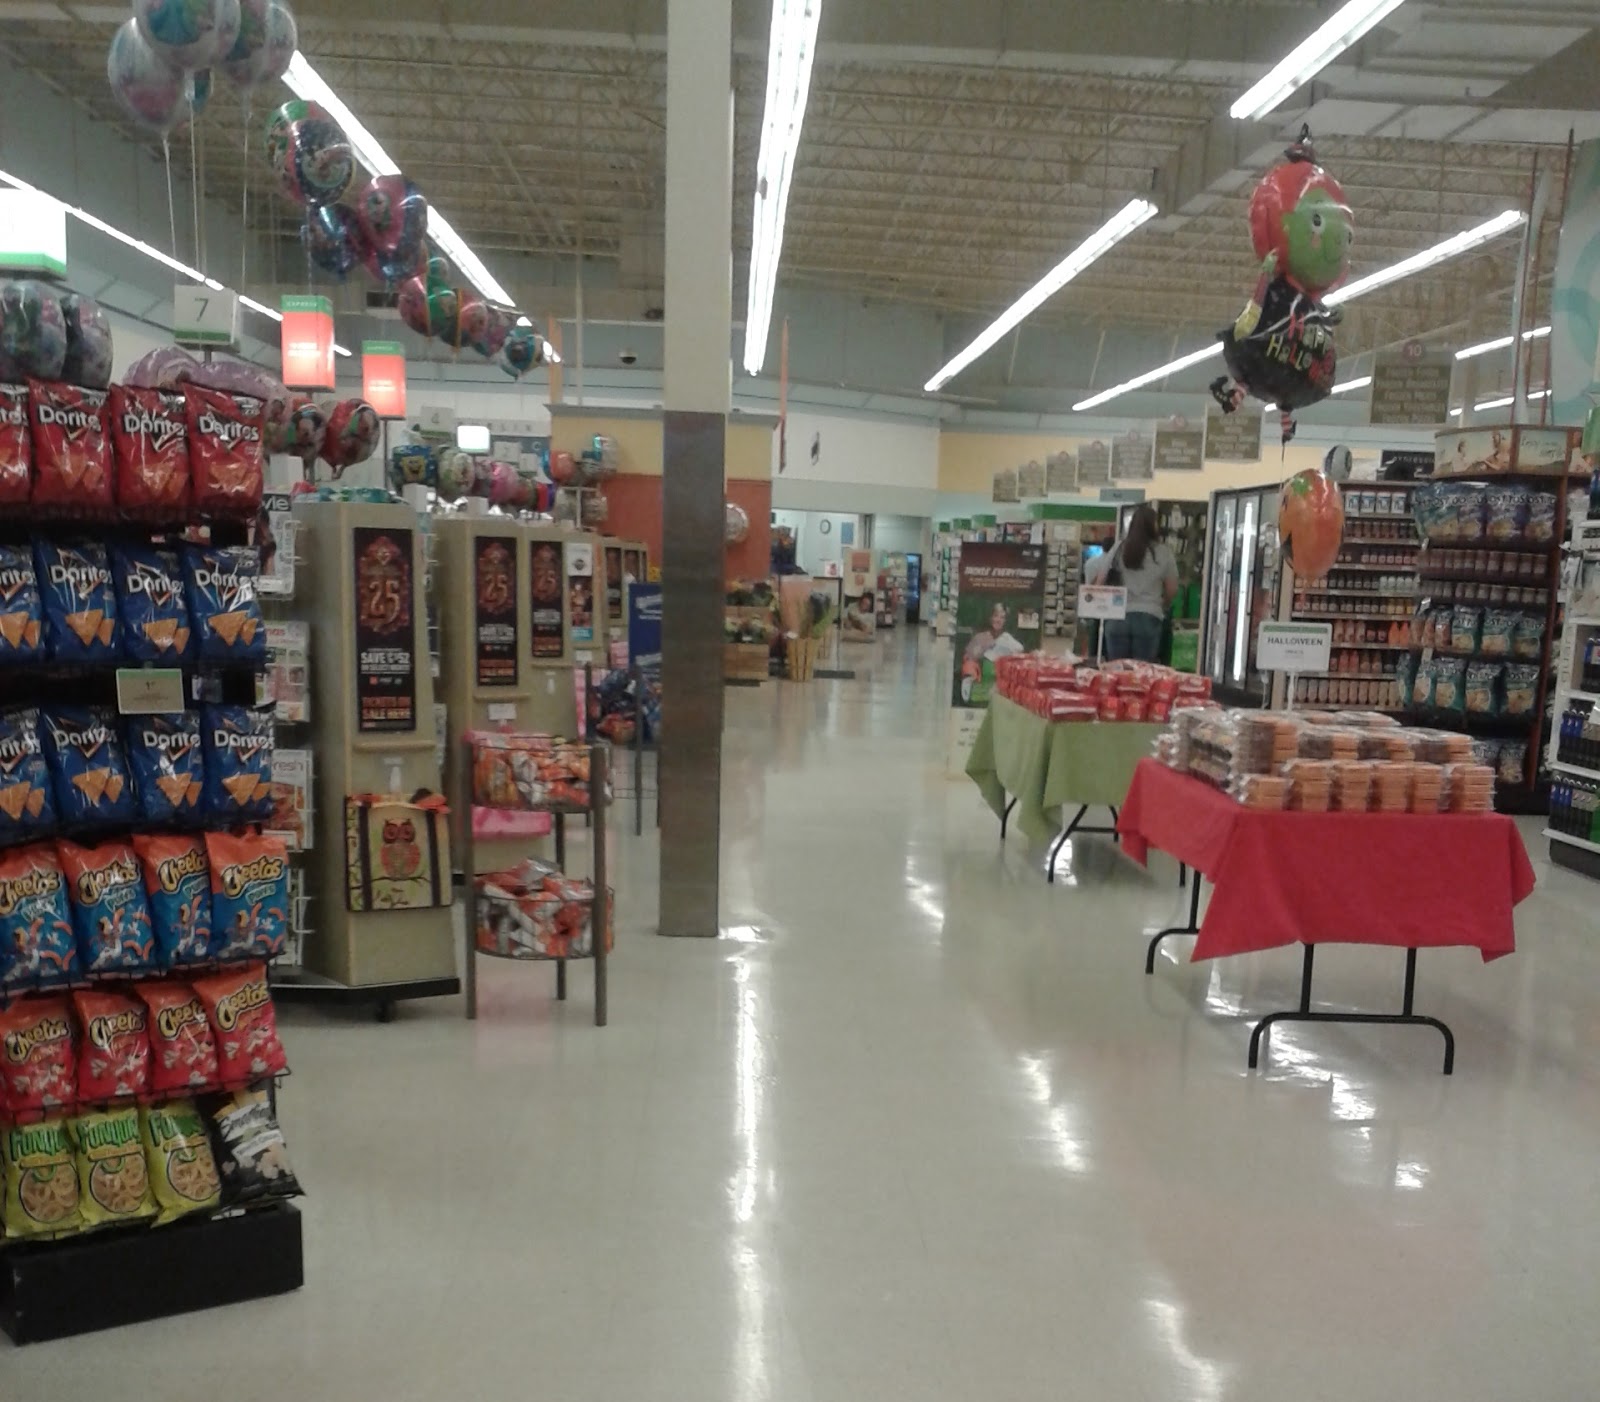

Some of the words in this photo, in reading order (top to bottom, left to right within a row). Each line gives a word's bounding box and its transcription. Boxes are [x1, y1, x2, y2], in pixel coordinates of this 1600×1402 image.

[194, 297, 209, 322] 7
[1407, 344, 1422, 357] 10
[199, 413, 260, 442] Doritos
[0, 566, 36, 585] ritos
[195, 569, 259, 590] Doritos
[1267, 636, 1323, 646] HALLOWEEN
[360, 652, 386, 664] SAVE
[143, 731, 200, 750] Dorito
[78, 859, 140, 904] Cheetos
[158, 848, 208, 894] Cheeto
[222, 856, 284, 898] Cheetos
[217, 981, 269, 1031] Cheetos
[5, 1018, 69, 1064] Cheetos
